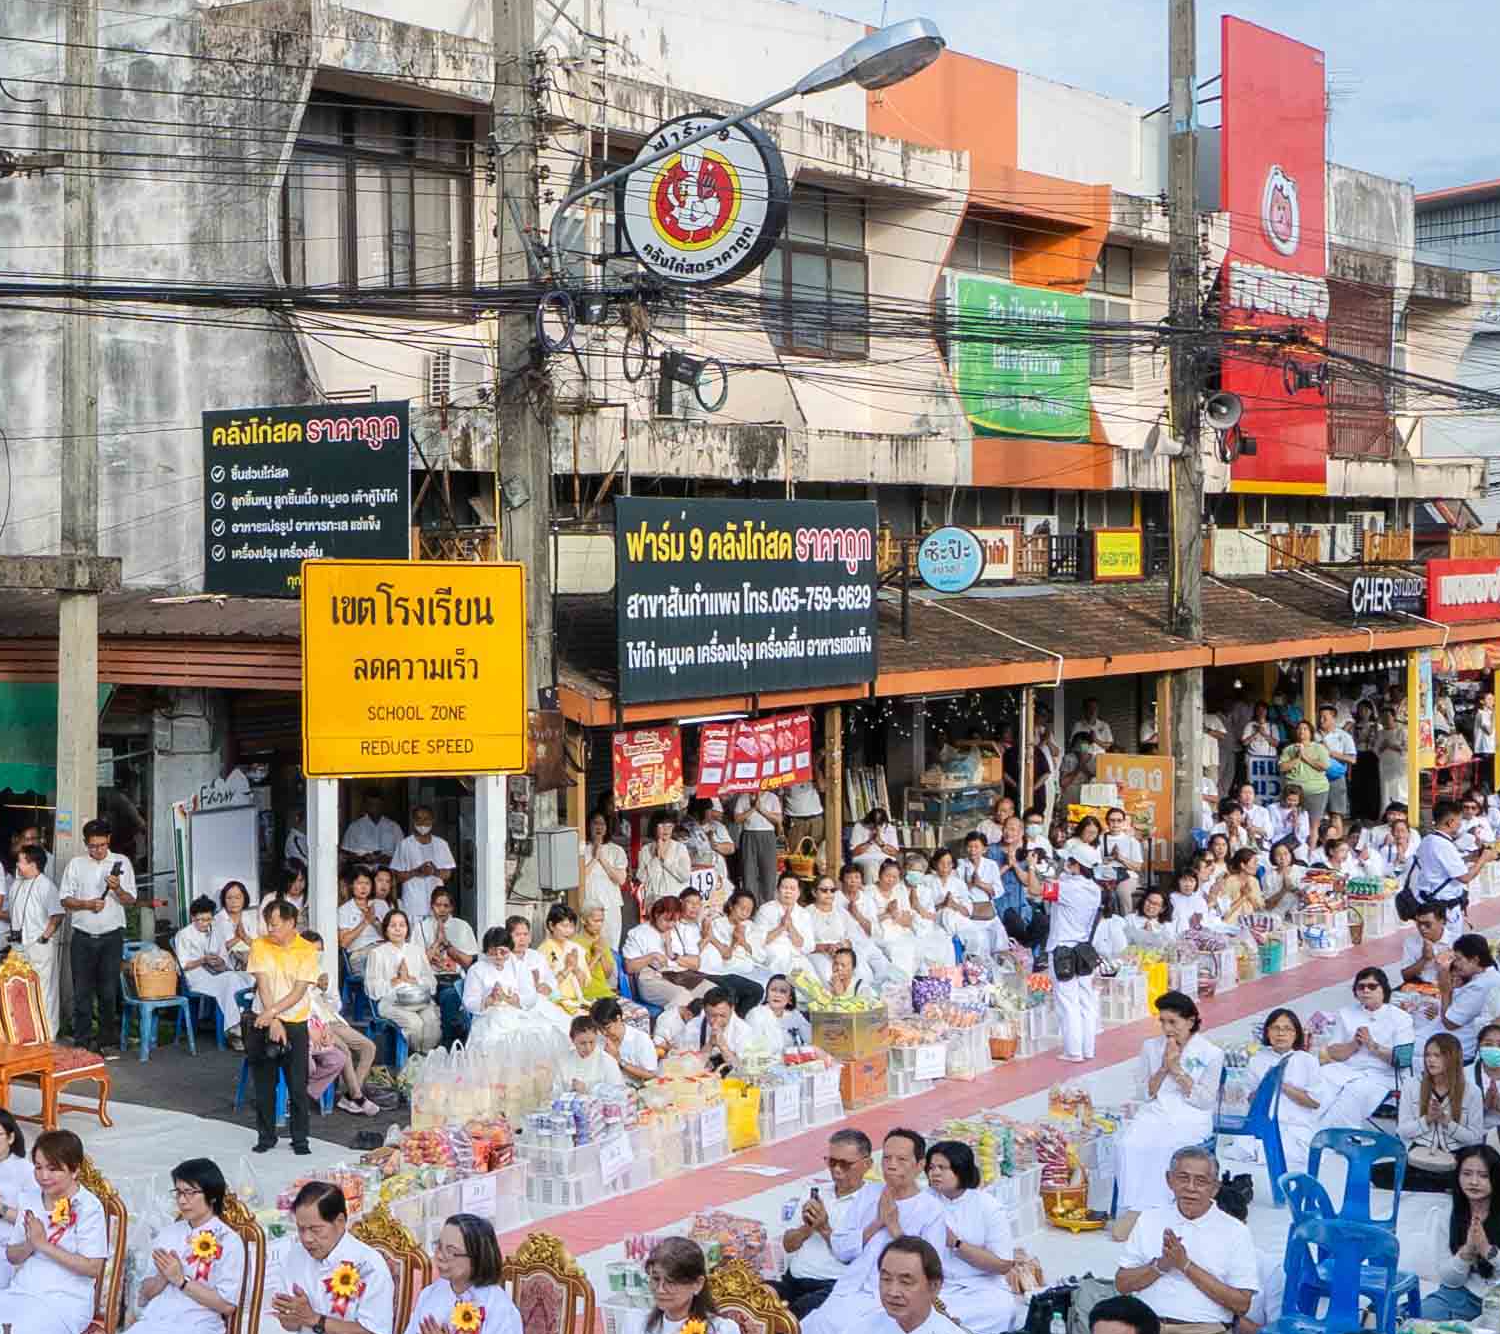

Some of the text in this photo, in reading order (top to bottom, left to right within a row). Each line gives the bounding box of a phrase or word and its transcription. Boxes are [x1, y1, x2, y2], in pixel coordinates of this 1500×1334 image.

[211, 415, 401, 450] คลังไก่สด ราคาถูก
[626, 519, 872, 575] ฟาร์ม 9 คลังไก่สด ราคาถูก
[627, 581, 871, 619] สาขาสันกำแพง โทร.065-759-9629
[1352, 576, 1423, 613] CHER STUDIO
[353, 648, 480, 681] ลดความเร็ว
[626, 625, 872, 674] ไข่ไก่ หมูบด เครื่องปรุง เครื่องดื่ม อาหารแช่แข็ง
[368, 705, 467, 721] SCHOOL ZONE
[360, 739, 474, 756] REDUCE SPEED
